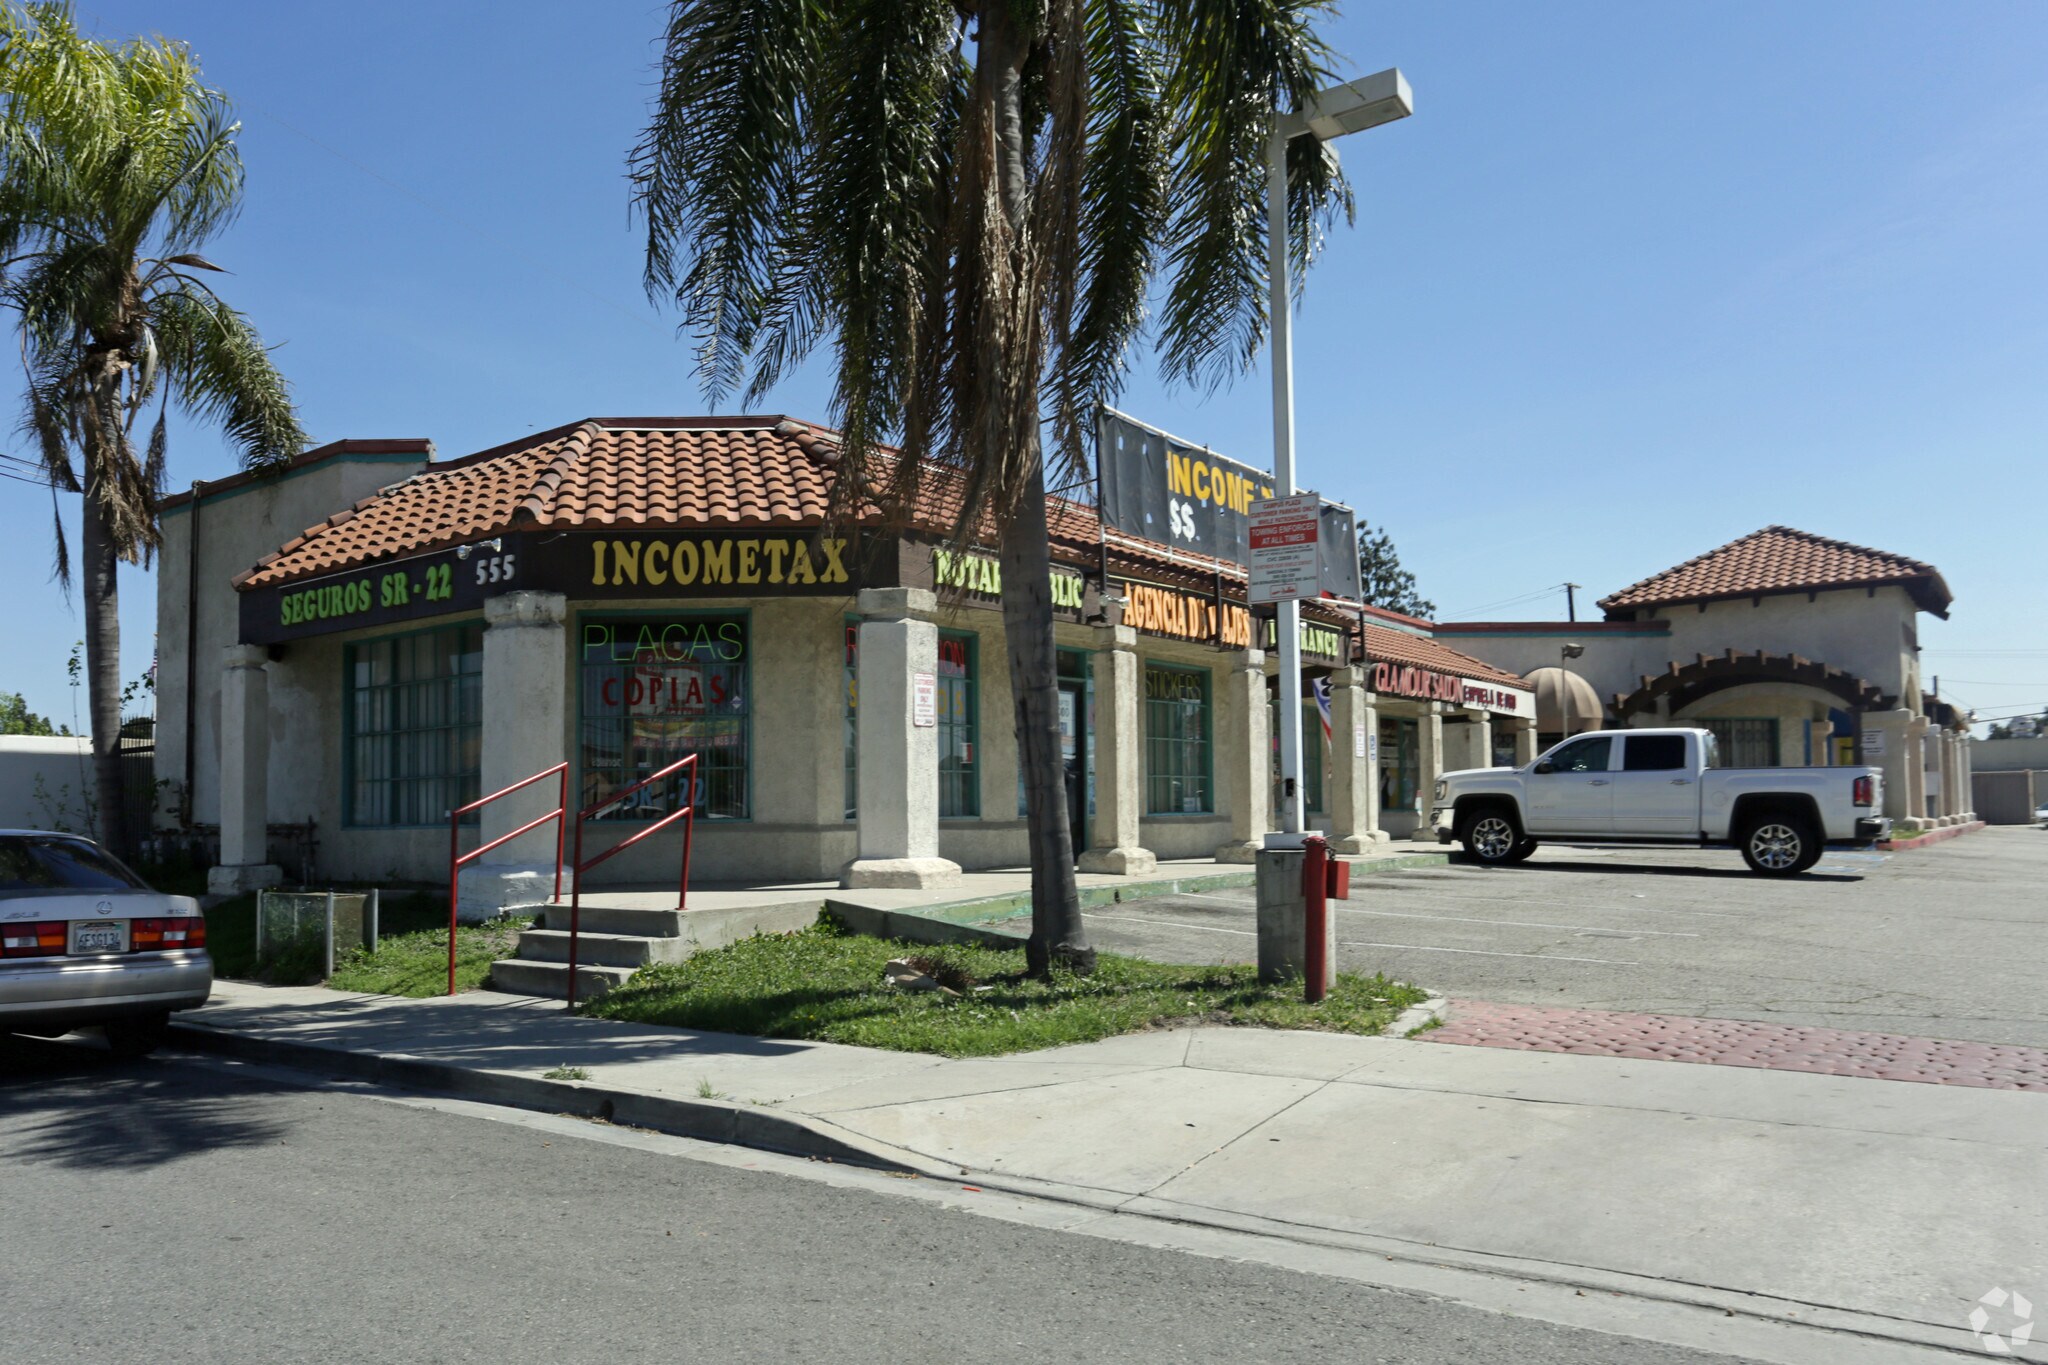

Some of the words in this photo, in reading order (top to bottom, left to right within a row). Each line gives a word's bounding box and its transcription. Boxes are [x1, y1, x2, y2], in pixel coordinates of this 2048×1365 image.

[1279, 507, 1301, 515] PARKING
[1251, 527, 1278, 537] TOWING
[1279, 522, 1316, 534] ENFORCED
[1261, 537, 1271, 545] AT
[1271, 536, 1284, 544] ALL
[1285, 534, 1306, 543] TIMES
[475, 554, 516, 585] 555
[592, 538, 849, 586] INCOMETAX
[280, 579, 372, 626] SEGUROS
[1124, 582, 1188, 636] AGENCIA
[1207, 603, 1250, 647] VAJES
[584, 623, 743, 661] PLACAS
[602, 675, 725, 706] COPIAS
[1146, 669, 1201, 700] STICKERS
[1375, 662, 1431, 698] GLAMOUR
[1431, 672, 1463, 703] SALON
